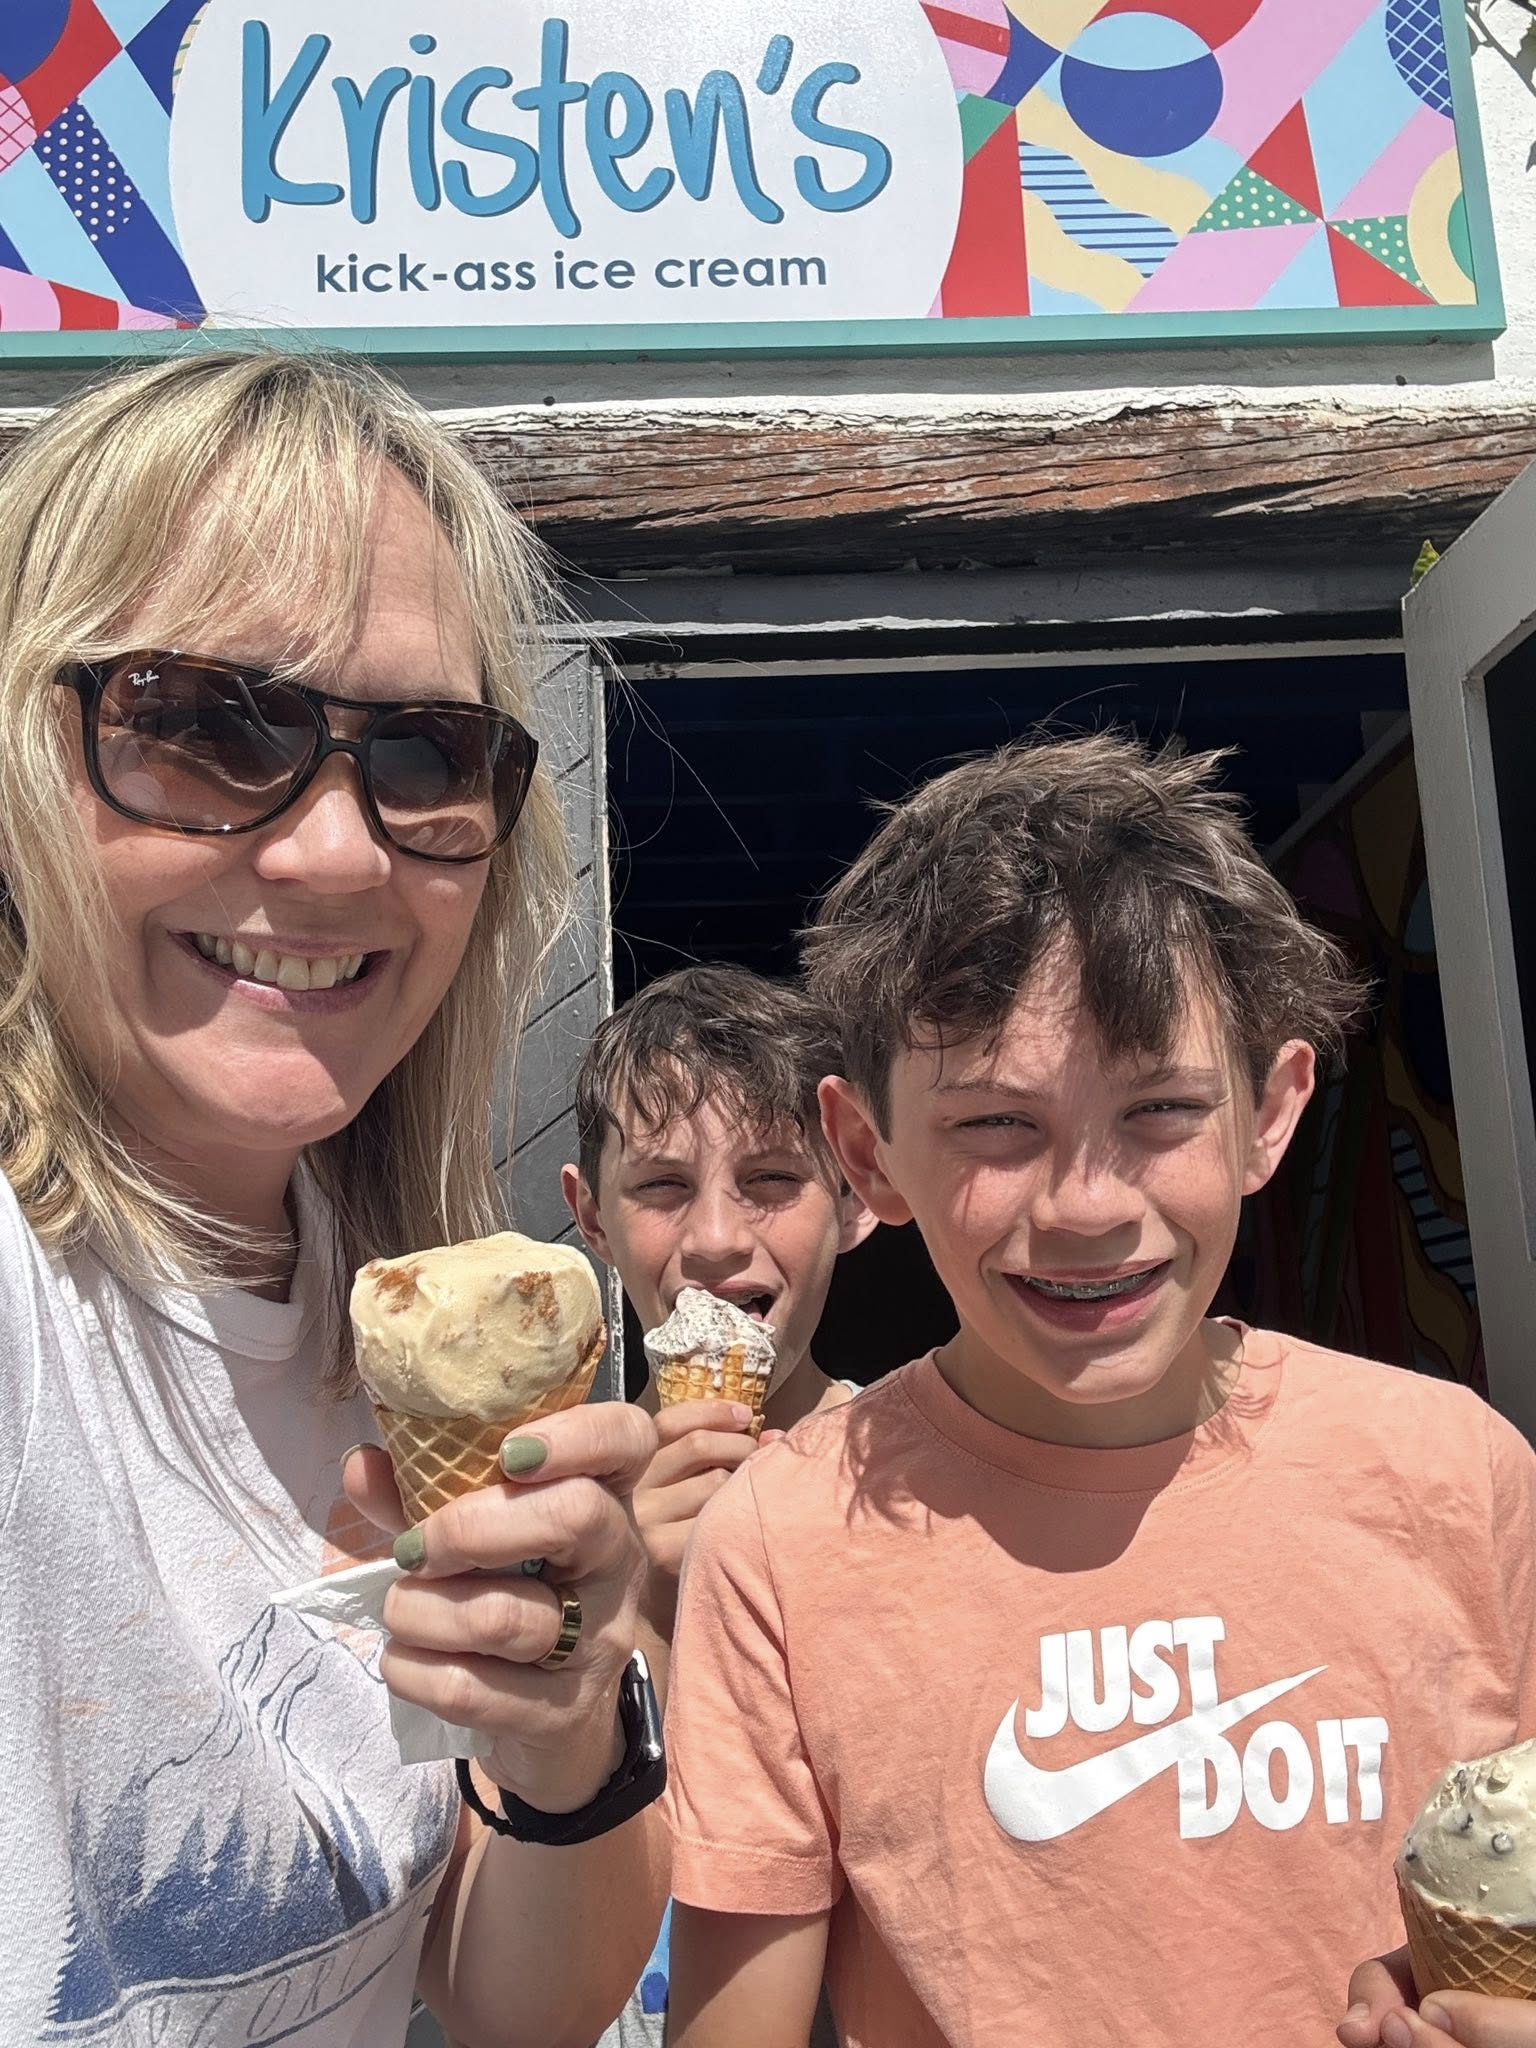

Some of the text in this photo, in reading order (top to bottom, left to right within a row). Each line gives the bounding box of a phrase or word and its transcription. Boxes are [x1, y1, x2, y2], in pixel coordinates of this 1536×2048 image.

[241, 18, 892, 239] Kristen's
[316, 250, 828, 294] kick-ass ice cream
[1025, 1616, 1226, 1738] JUST
[1178, 1716, 1389, 1840] DO IT
